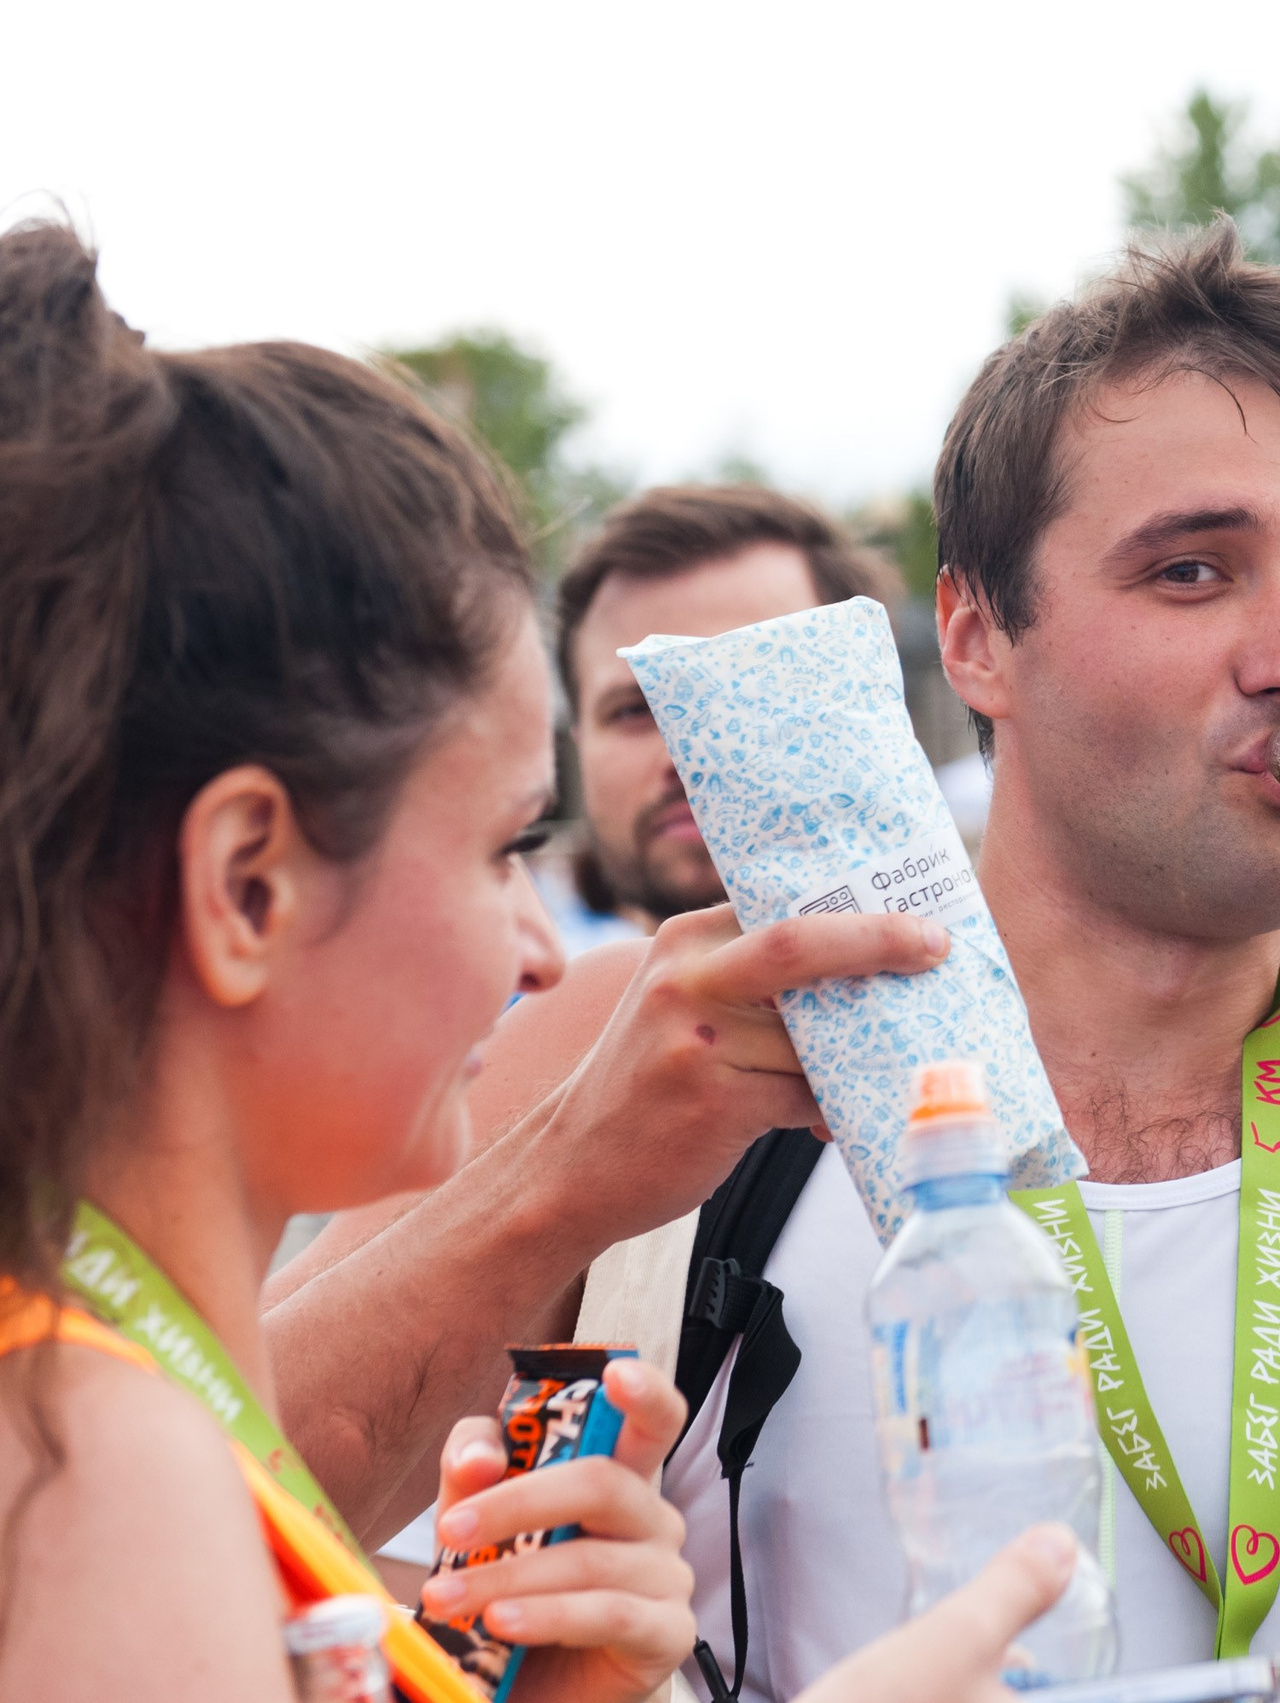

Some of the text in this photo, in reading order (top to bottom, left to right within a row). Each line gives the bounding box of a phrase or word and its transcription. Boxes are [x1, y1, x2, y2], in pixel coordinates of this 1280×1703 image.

[883, 865, 977, 914] Гастроно
[1076, 1307, 1125, 1392] РАДИ
[1106, 1405, 1168, 1492] ЗАБЕГ
[1246, 1392, 1279, 1491] ЗАБЕГ
